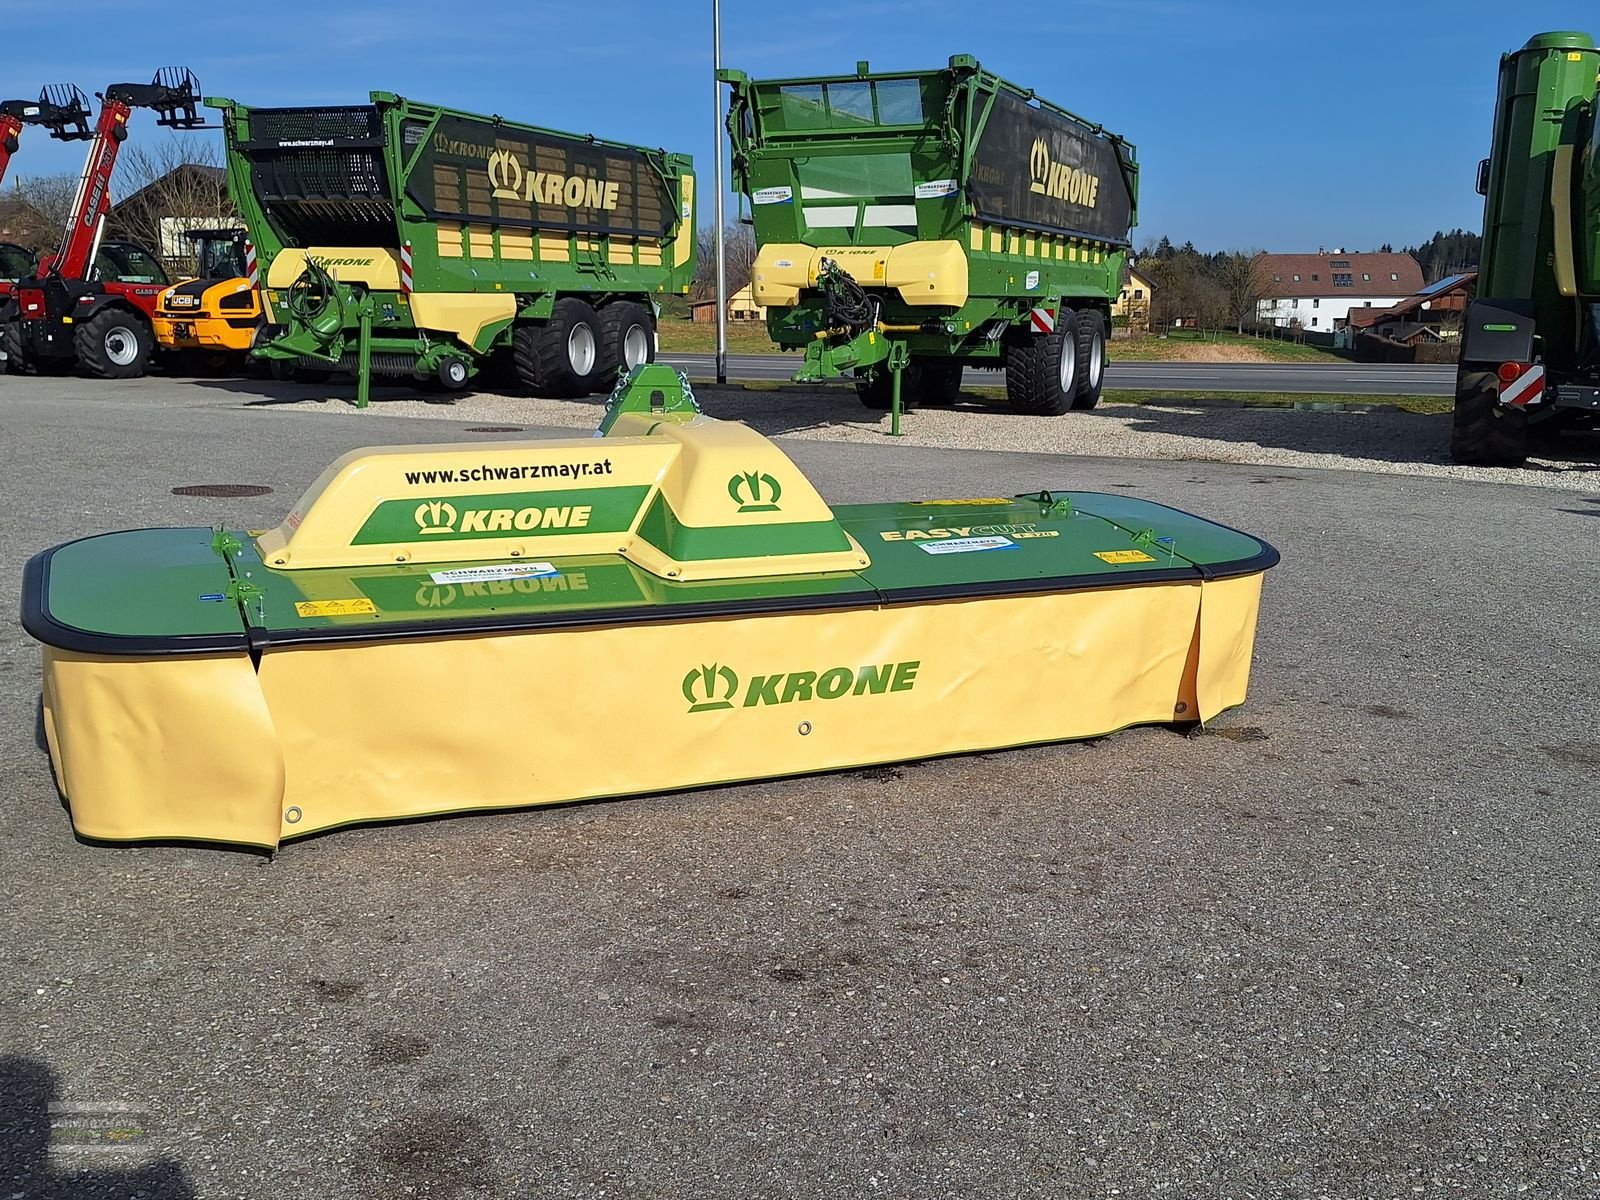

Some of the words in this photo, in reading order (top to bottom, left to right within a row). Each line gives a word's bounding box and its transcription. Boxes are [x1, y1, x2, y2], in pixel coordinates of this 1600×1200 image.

[279, 139, 334, 147] www.schwarzmayr.at
[525, 170, 620, 210] KRONE
[1046, 161, 1099, 208] KRONE
[325, 258, 375, 266] KRONE
[173, 297, 192, 305] JCB
[405, 458, 613, 485] www.schwarzmayr.at
[459, 505, 592, 533] KRONE
[880, 523, 1036, 542] EASYCUT
[441, 566, 538, 576] SCHWARZMAYR
[743, 661, 921, 708] KRONE
